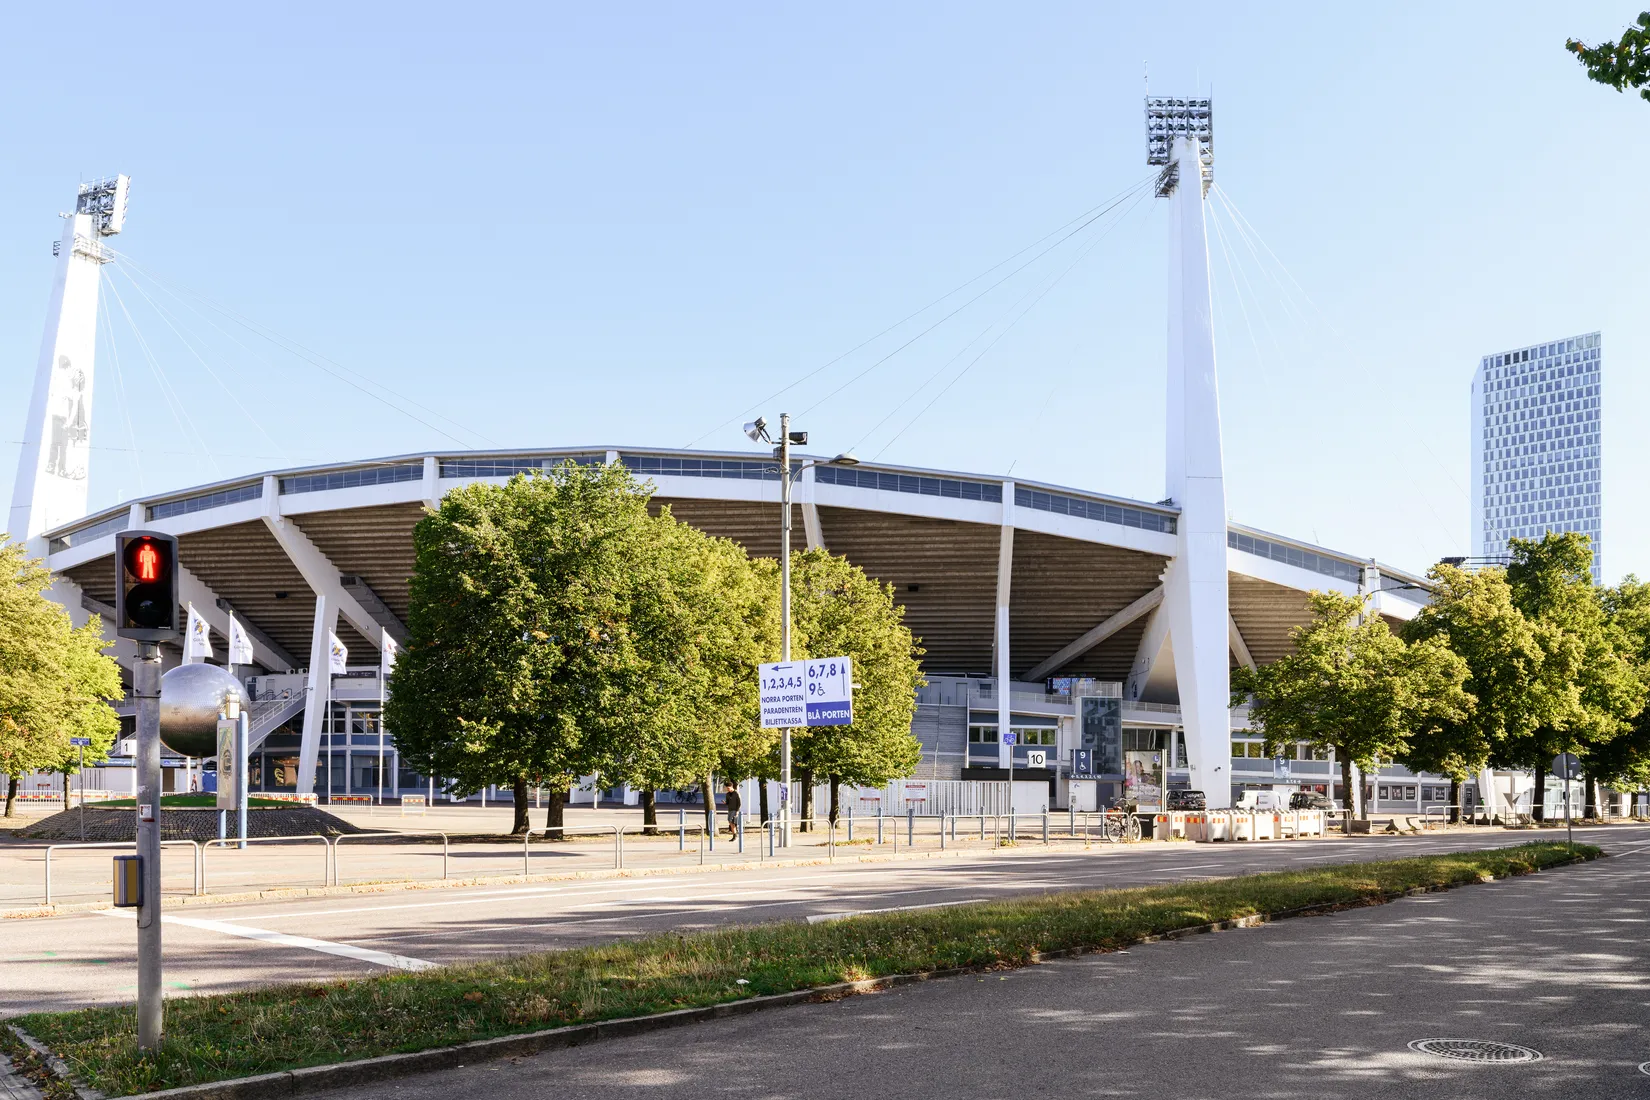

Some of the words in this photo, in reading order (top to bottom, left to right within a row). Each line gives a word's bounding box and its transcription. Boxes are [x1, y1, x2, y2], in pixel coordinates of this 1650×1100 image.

[808, 664, 836, 679] 6,7,8
[763, 676, 802, 690] 1,2,3,4,5
[809, 683, 816, 695] 9
[808, 709, 820, 720] BLÅ
[822, 710, 850, 719] PORTEN
[124, 743, 128, 752] 1
[1031, 754, 1043, 764] 10
